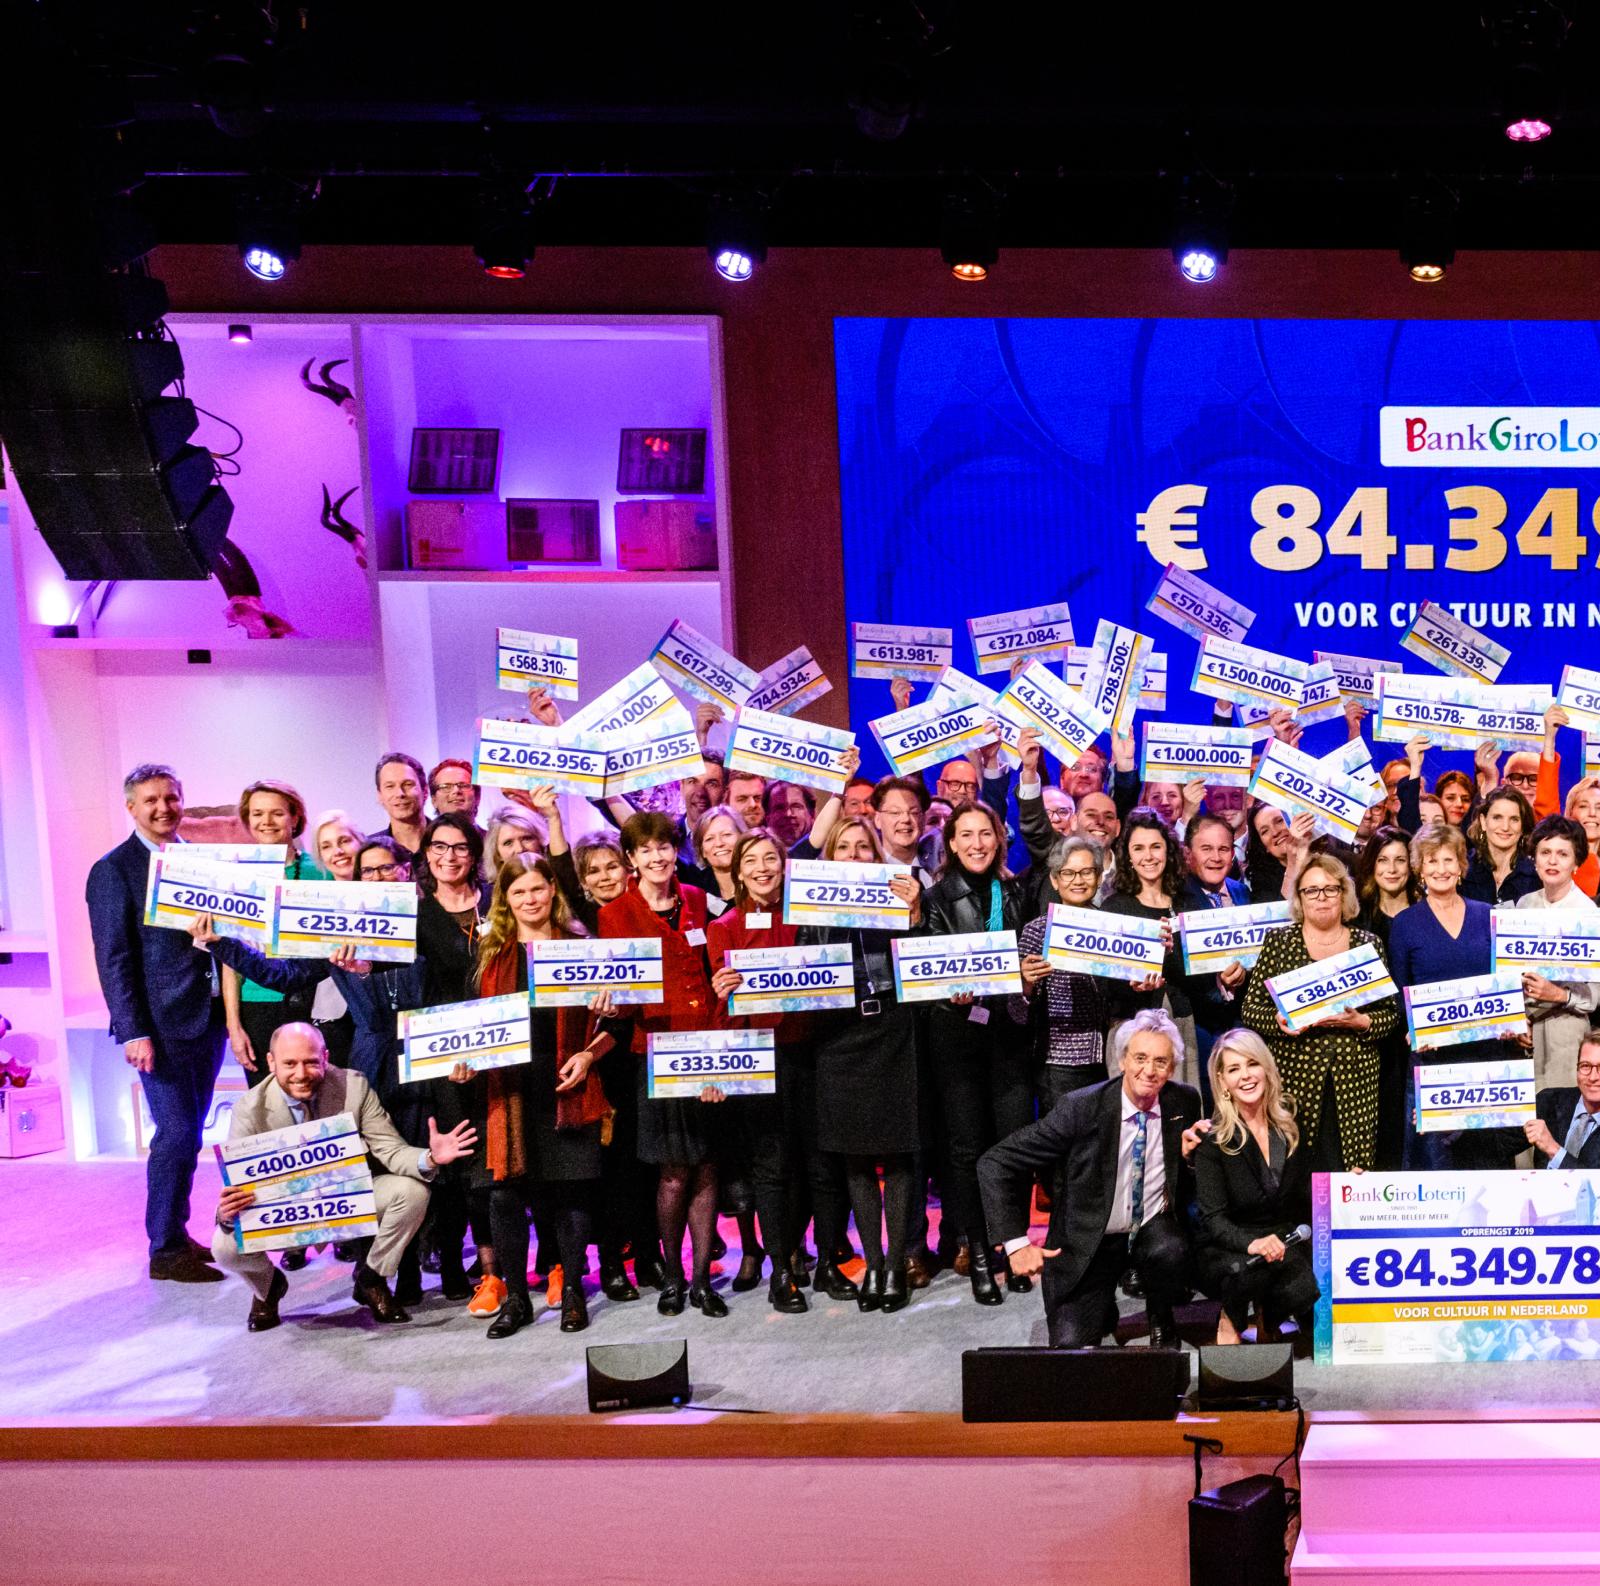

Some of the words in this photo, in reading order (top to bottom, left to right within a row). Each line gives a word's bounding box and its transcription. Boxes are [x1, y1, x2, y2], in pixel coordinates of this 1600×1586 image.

[1136, 484, 1207, 571] €
[1170, 591, 1234, 635] €570.336,-
[1294, 602, 1379, 628] VOOR
[1389, 602, 1532, 628] CTUUR
[1543, 603, 1576, 628] IN
[989, 627, 1062, 651] €372.084,-
[1427, 627, 1488, 674] €261.339,-
[509, 654, 567, 676] €568.310,-
[869, 647, 940, 663] €613.981,-
[673, 649, 736, 698] €617.299,-
[1101, 641, 1132, 715] €798.500,-
[1207, 662, 1296, 697] €1.500.000,-
[749, 671, 811, 711] 744.934,-
[1017, 684, 1088, 745] €4.332.499,-
[1395, 705, 1466, 725] €510.578,-
[1478, 714, 1541, 733] 487.158,-
[900, 714, 974, 750] €500.000,-
[487, 748, 598, 772] €2.062.956,-
[750, 737, 836, 768] €375.000,-
[1153, 747, 1246, 765] €1.000.000,-
[1274, 770, 1351, 817] €202.372,-
[173, 890, 265, 918] €200.000,-
[806, 886, 895, 907] €279.255,-
[298, 914, 399, 936] €253.412,-
[1064, 932, 1151, 960] €200.000,-
[1505, 941, 1596, 958] €8.747.561,-
[552, 964, 645, 981] €557.201,-
[910, 955, 1010, 976] €8.747.561,-
[747, 970, 839, 990] €500.000,-
[1296, 969, 1373, 1005] €384.130,-
[1426, 999, 1512, 1023] €280.493,-
[428, 1028, 512, 1053] €201.217,-
[669, 1053, 760, 1072] €333.500,-
[1430, 1085, 1526, 1106] €8.747.561,-
[245, 1143, 346, 1178] €400.000,-
[1341, 1184, 1466, 1204] BankGiroLoterij
[259, 1200, 357, 1225] €283.126,-
[1318, 1213, 1330, 1268] CHEQUE
[1461, 1228, 1512, 1237] OPBRENGST
[1514, 1227, 1534, 1235] 2019
[1393, 1307, 1429, 1318] VOOR
[1433, 1306, 1489, 1317] CULTUUR
[1493, 1305, 1506, 1316] IN
[1510, 1304, 1588, 1316] NEDERLAND
